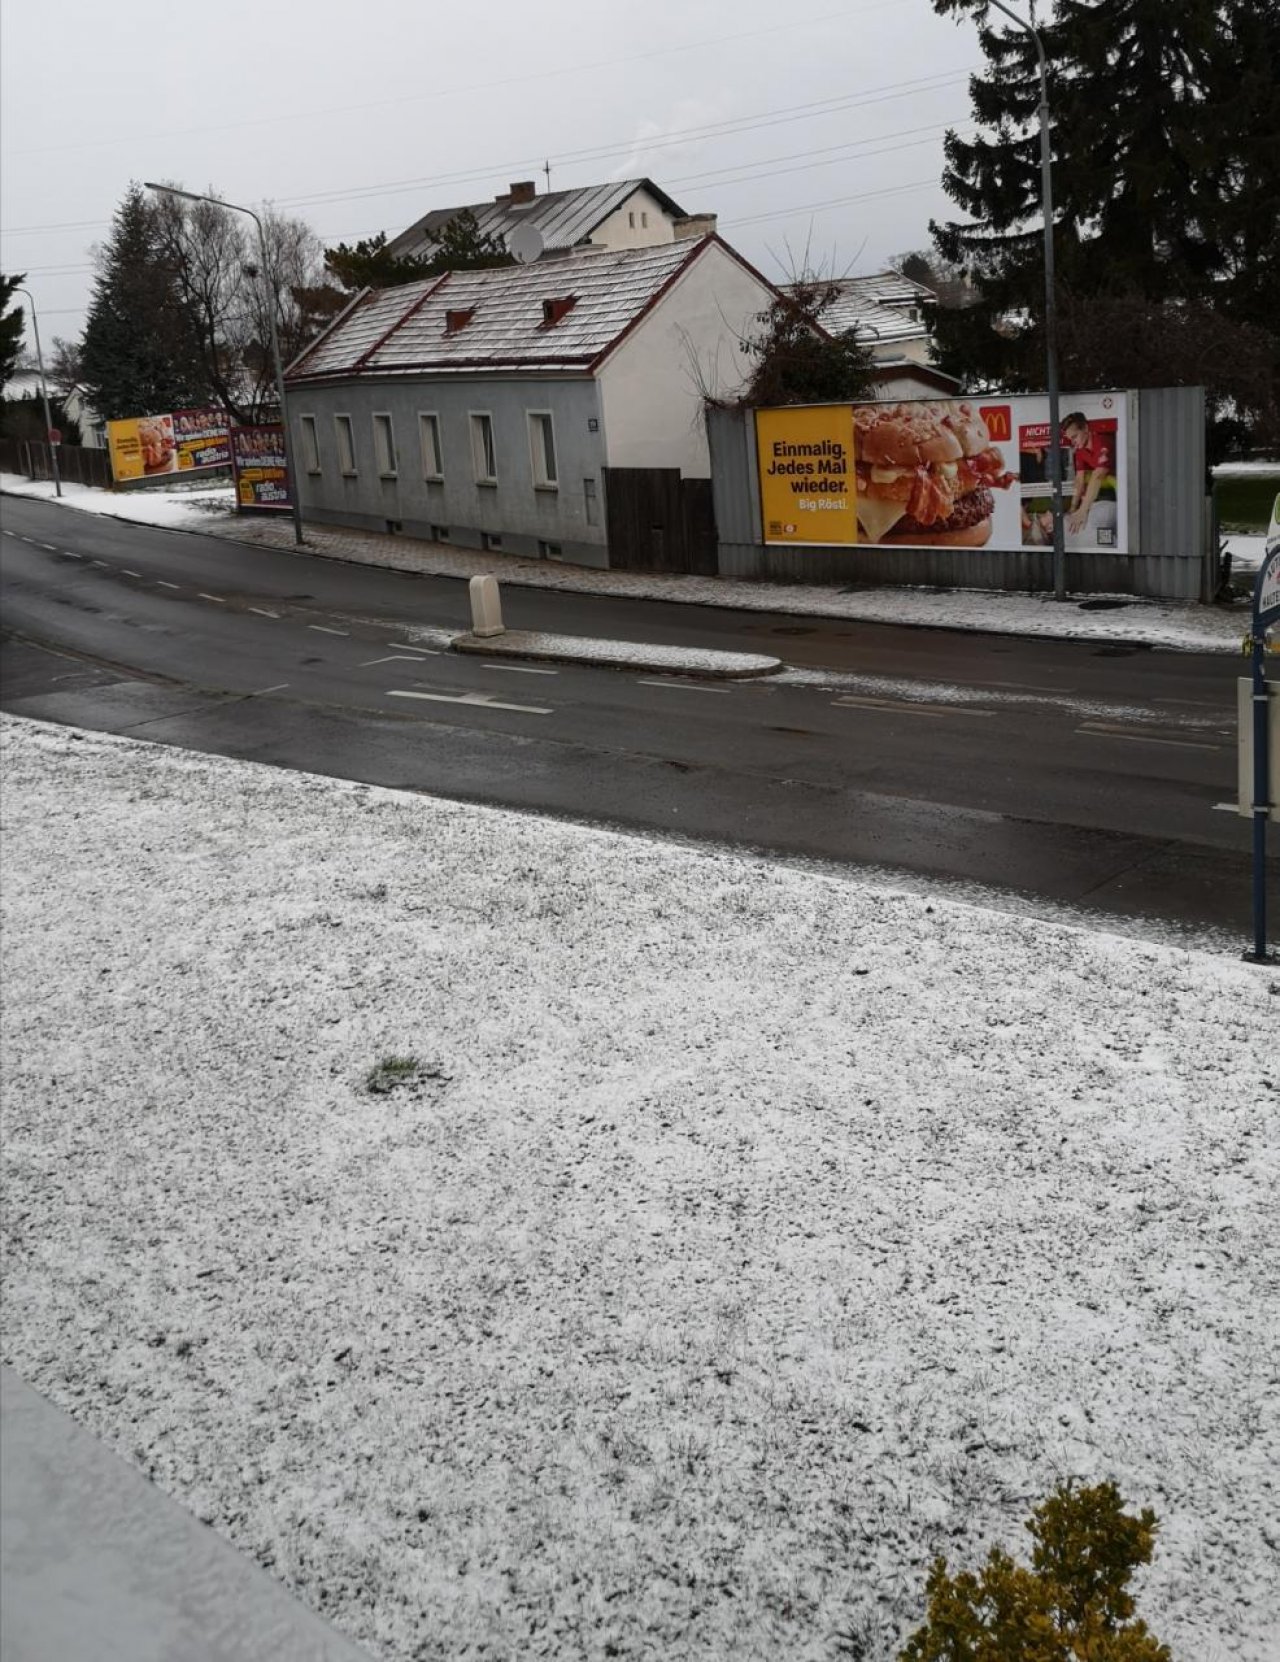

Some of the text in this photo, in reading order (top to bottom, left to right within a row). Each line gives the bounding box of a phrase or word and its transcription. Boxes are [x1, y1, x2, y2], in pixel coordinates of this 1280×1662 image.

[773, 439, 847, 459] Einmalig.
[767, 459, 847, 475] Jedes Mal
[791, 477, 848, 493] wieder.
[798, 498, 849, 512] Big Rösti.
